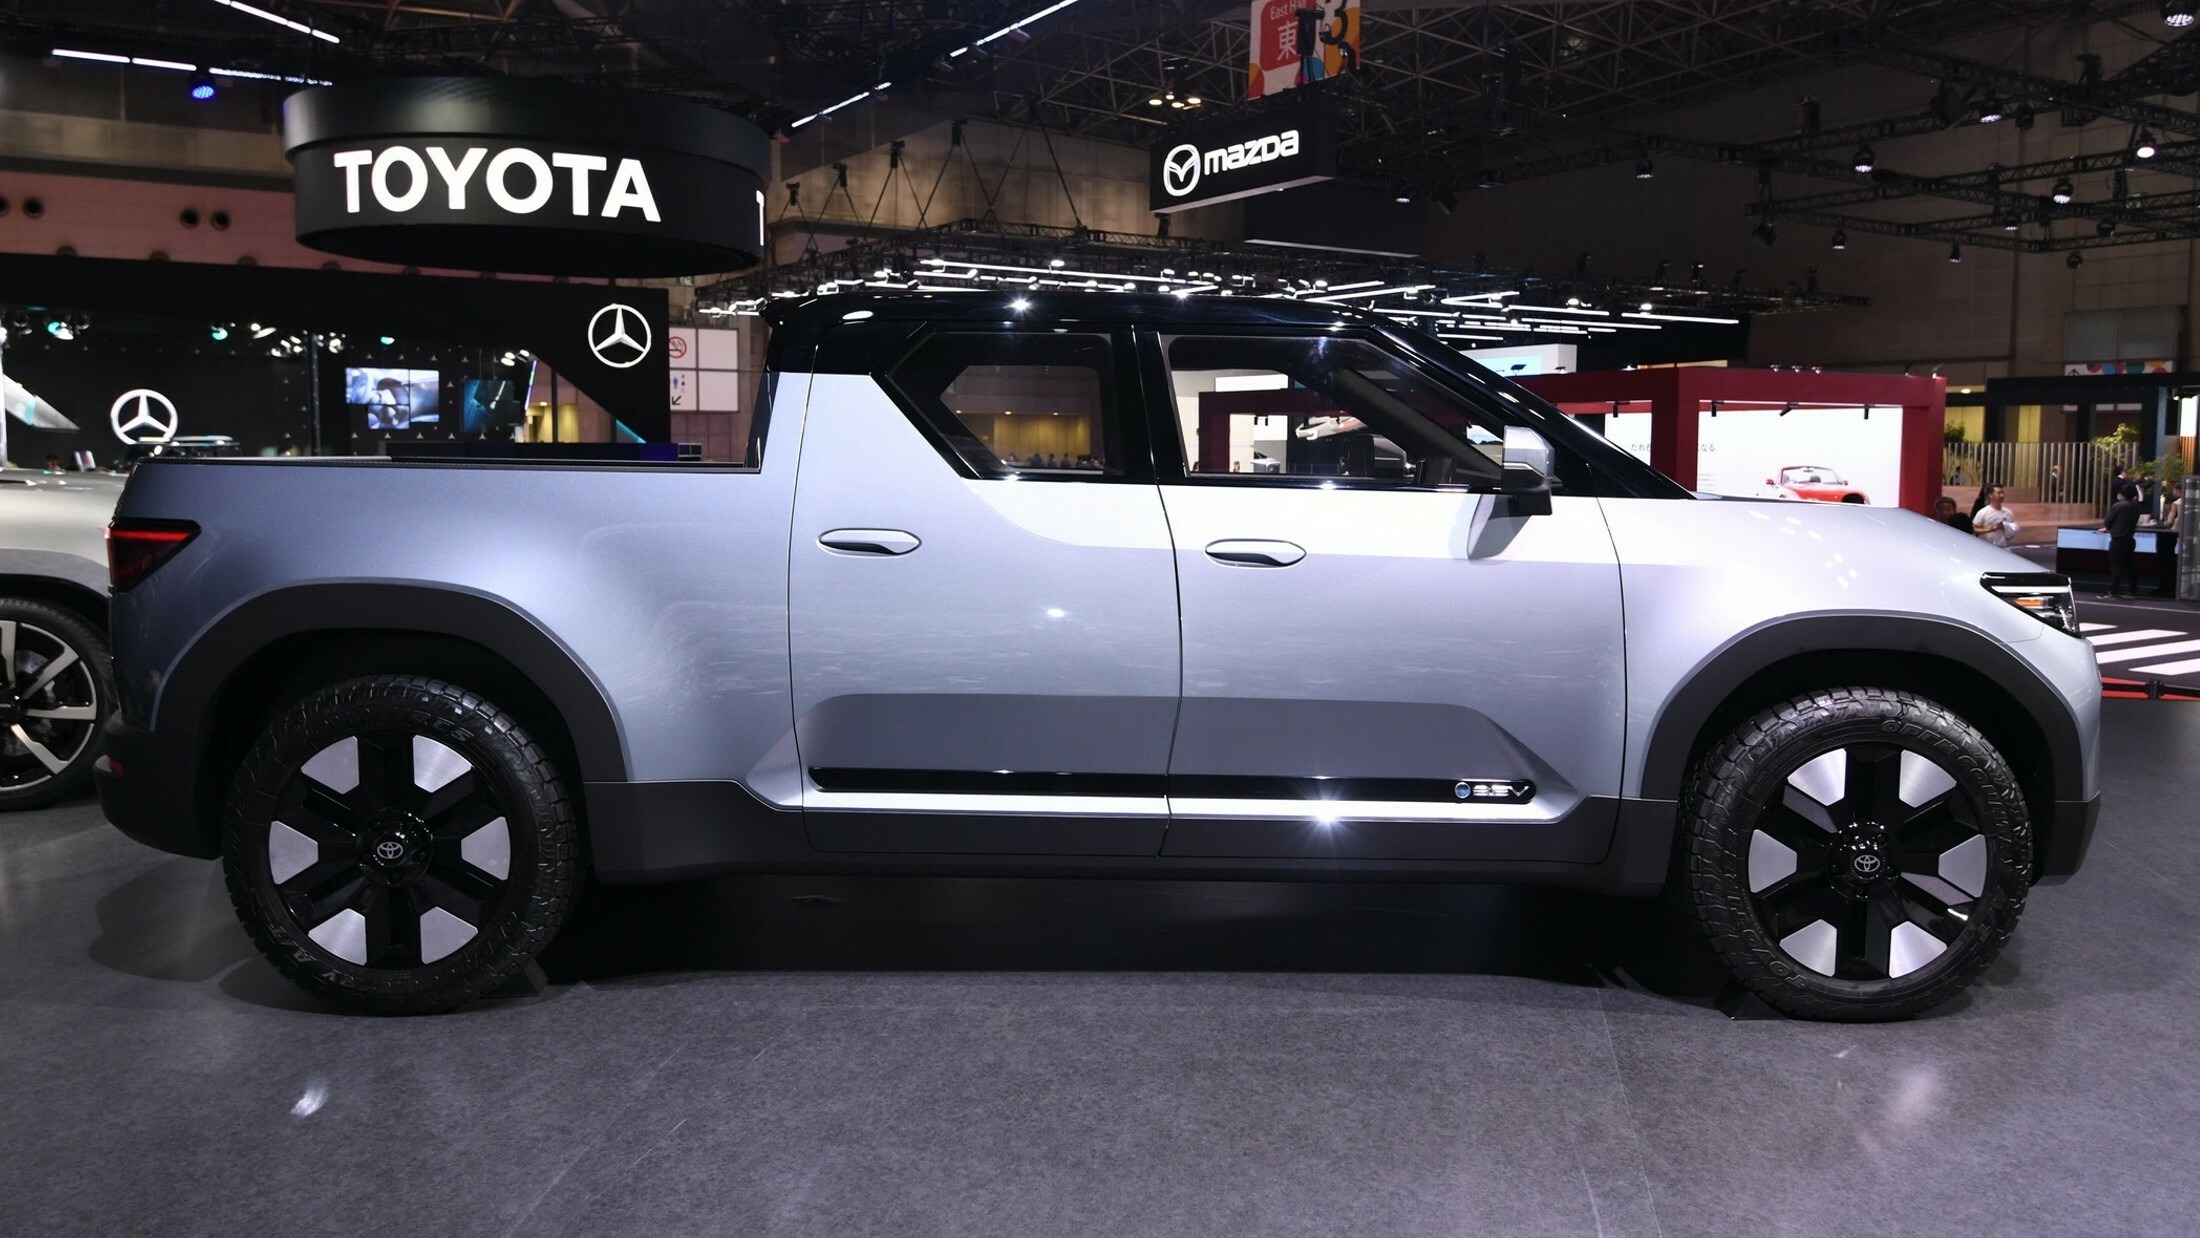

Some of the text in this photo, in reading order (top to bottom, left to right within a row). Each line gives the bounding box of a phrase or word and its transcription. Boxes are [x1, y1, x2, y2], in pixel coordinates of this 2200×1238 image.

[1270, 4, 1288, 20] East
[1277, 20, 1299, 61] 東
[1204, 129, 1300, 176] mazda
[333, 145, 662, 222] TOYOTA
[1880, 719, 1960, 755] OPEN
[1741, 929, 1808, 989] TOYO
